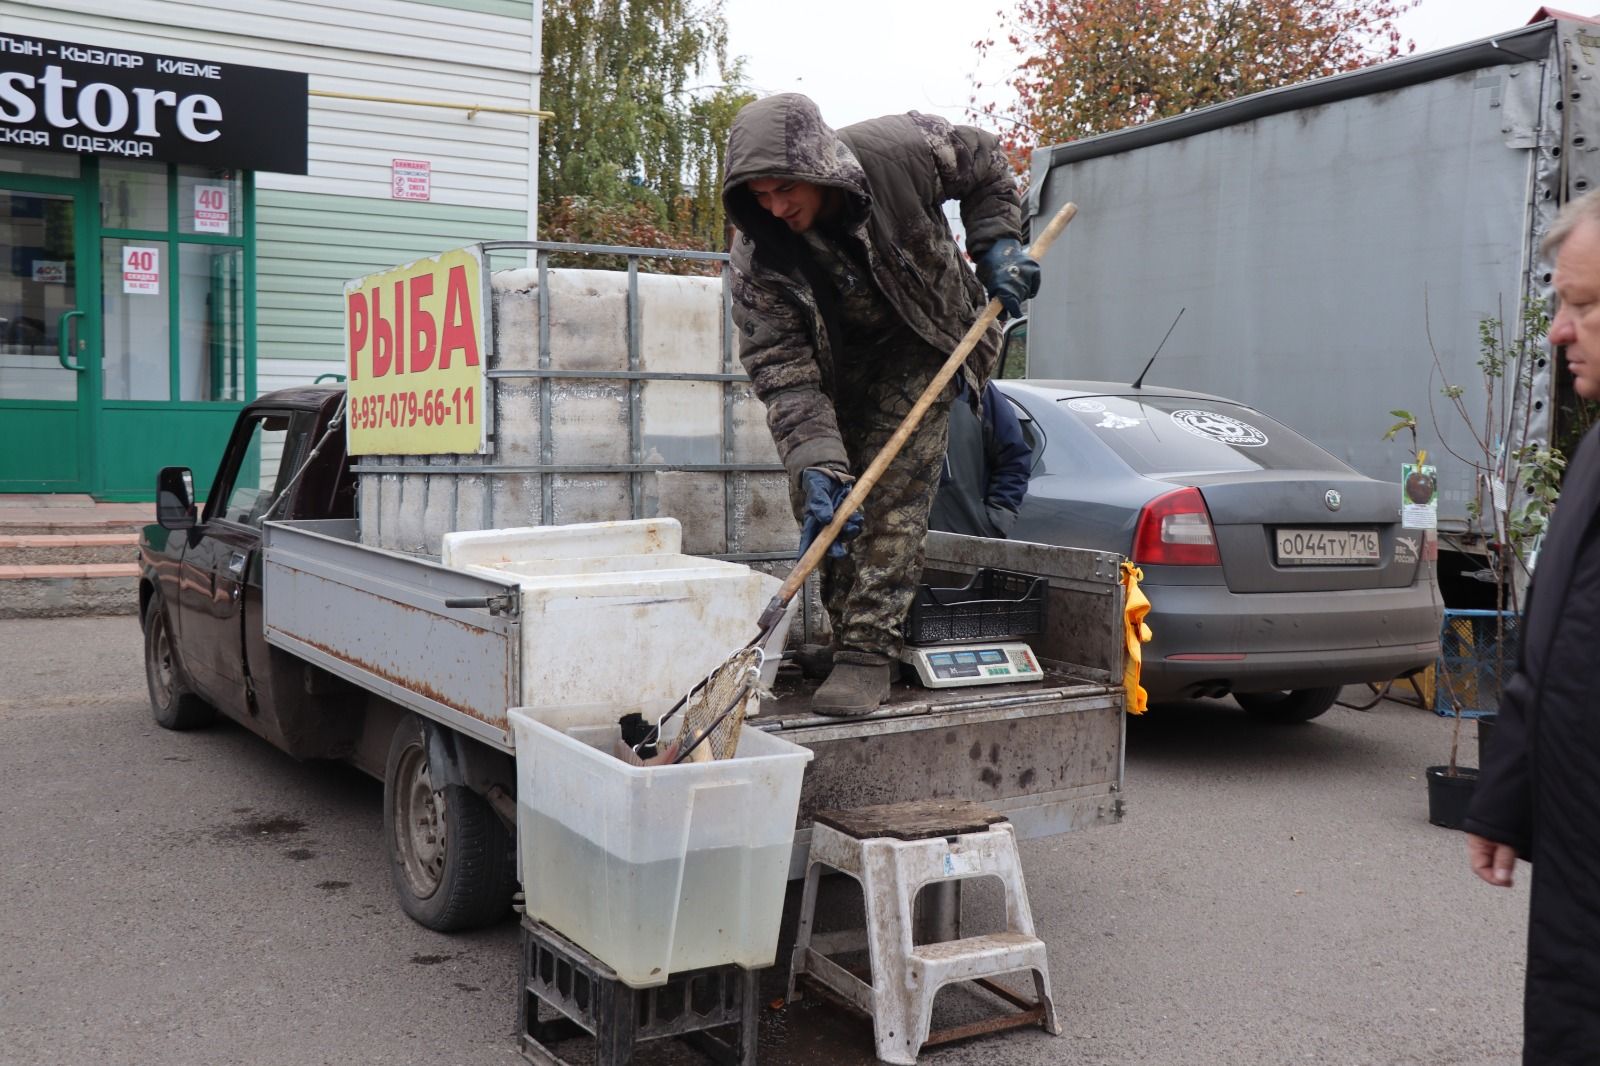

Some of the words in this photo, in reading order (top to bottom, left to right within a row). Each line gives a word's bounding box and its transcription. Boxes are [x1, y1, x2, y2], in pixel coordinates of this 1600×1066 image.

[156, 58, 222, 80] КИЕМЕ
[0, 65, 223, 142] store
[62, 133, 154, 157] ОДЕЖДА
[348, 264, 480, 381] РЫБА
[351, 386, 475, 430] 8-937-079-66-11
